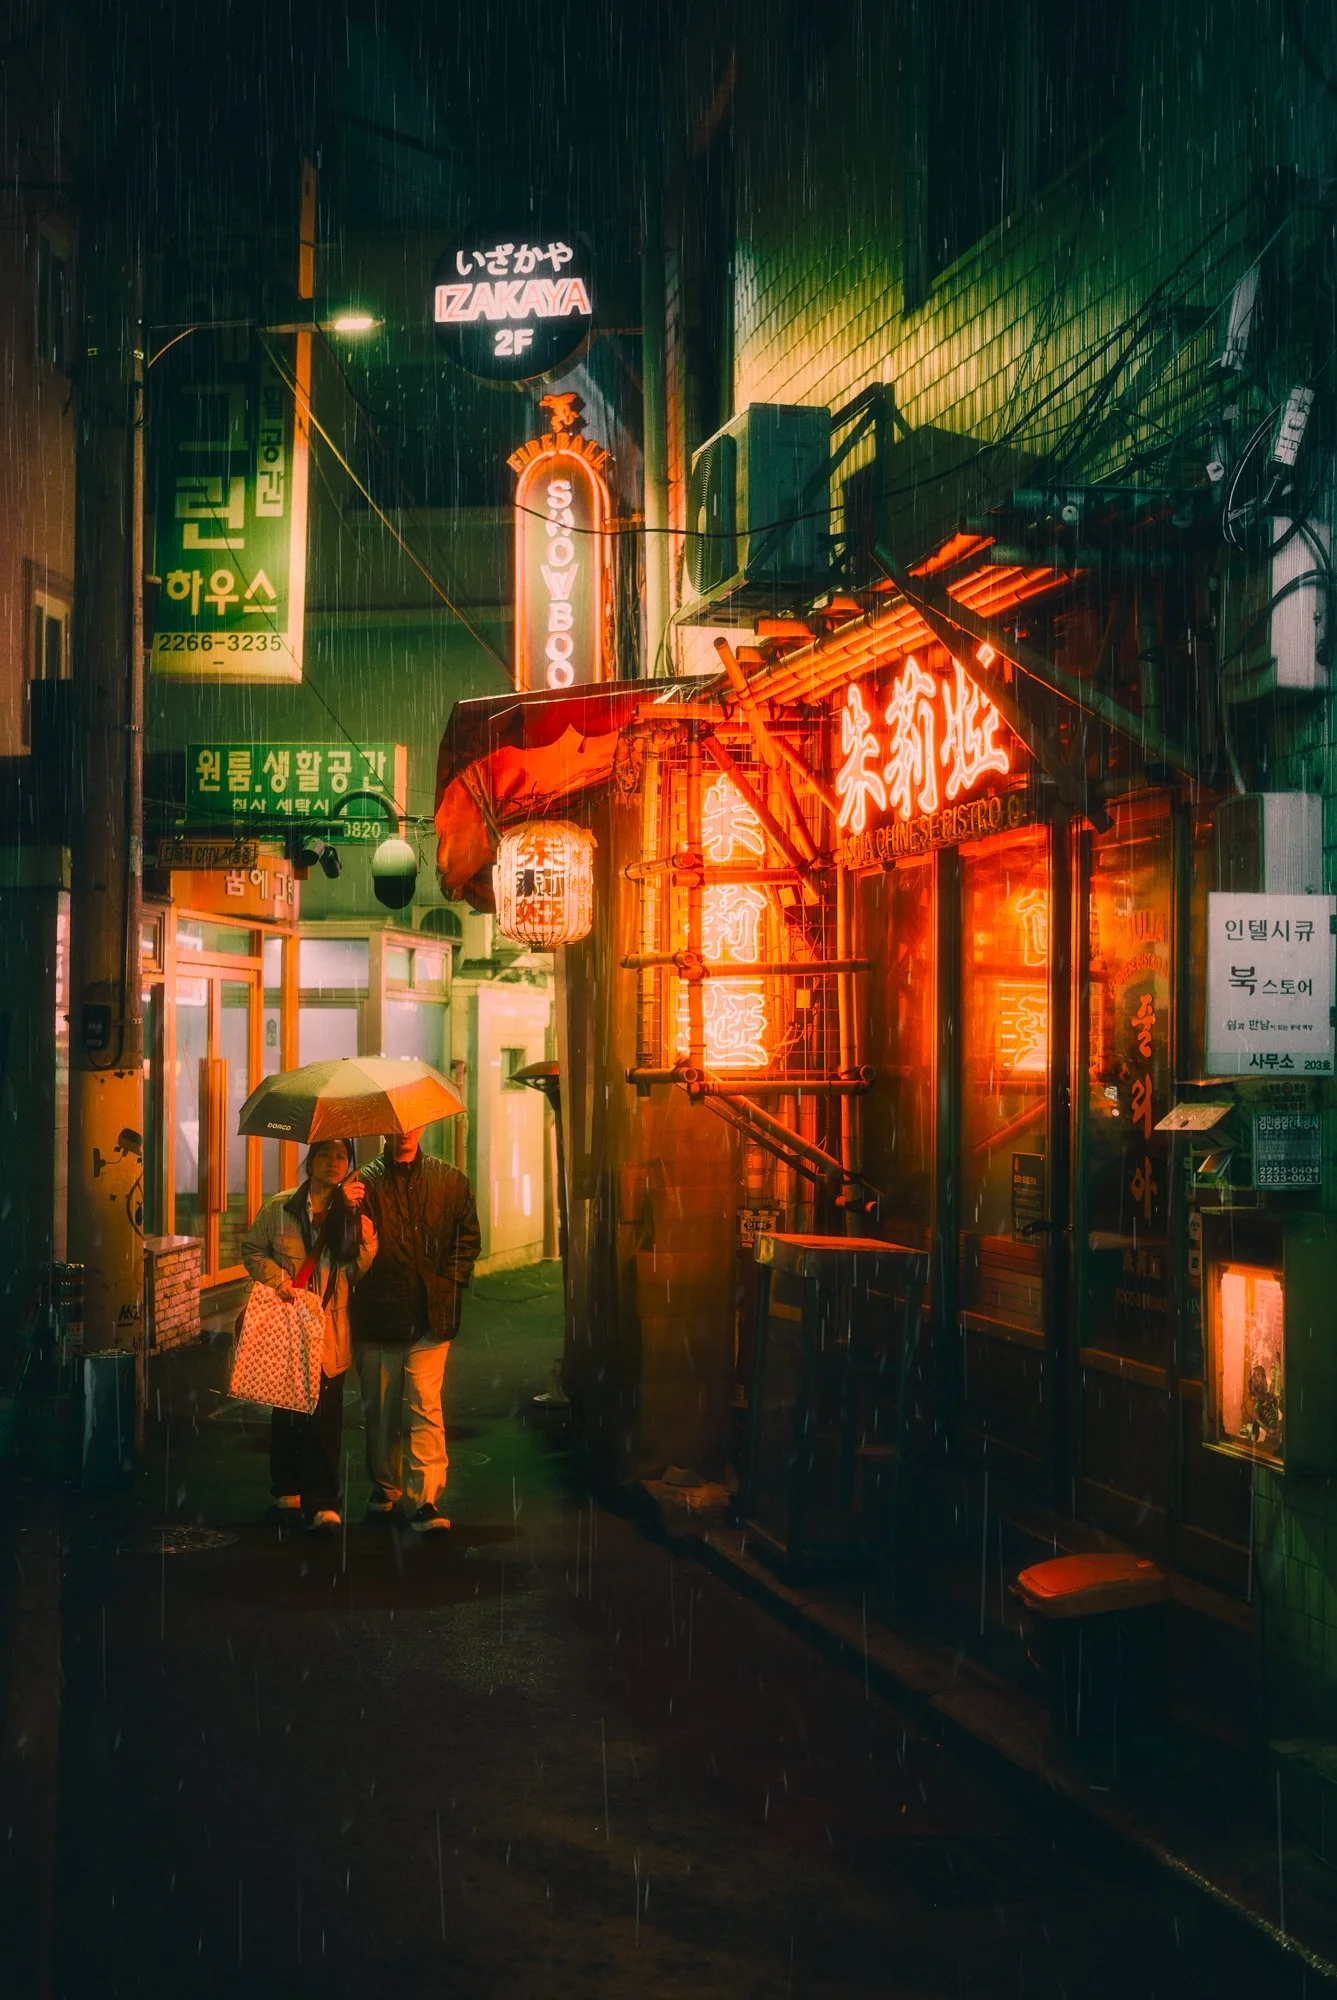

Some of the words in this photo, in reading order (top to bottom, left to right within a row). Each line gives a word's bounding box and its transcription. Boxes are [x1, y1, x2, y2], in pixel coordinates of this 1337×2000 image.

[435, 278, 593, 322] IZAKAYA
[494, 329, 534, 356] 2F
[506, 432, 608, 473] FIREBALL
[166, 569, 278, 616] 하우스
[159, 634, 282, 652] 2266-3235
[1225, 919, 1315, 942] 인텔시큐
[1249, 1053, 1295, 1070] 사무소
[1130, 993, 1158, 1219] 줄리아
